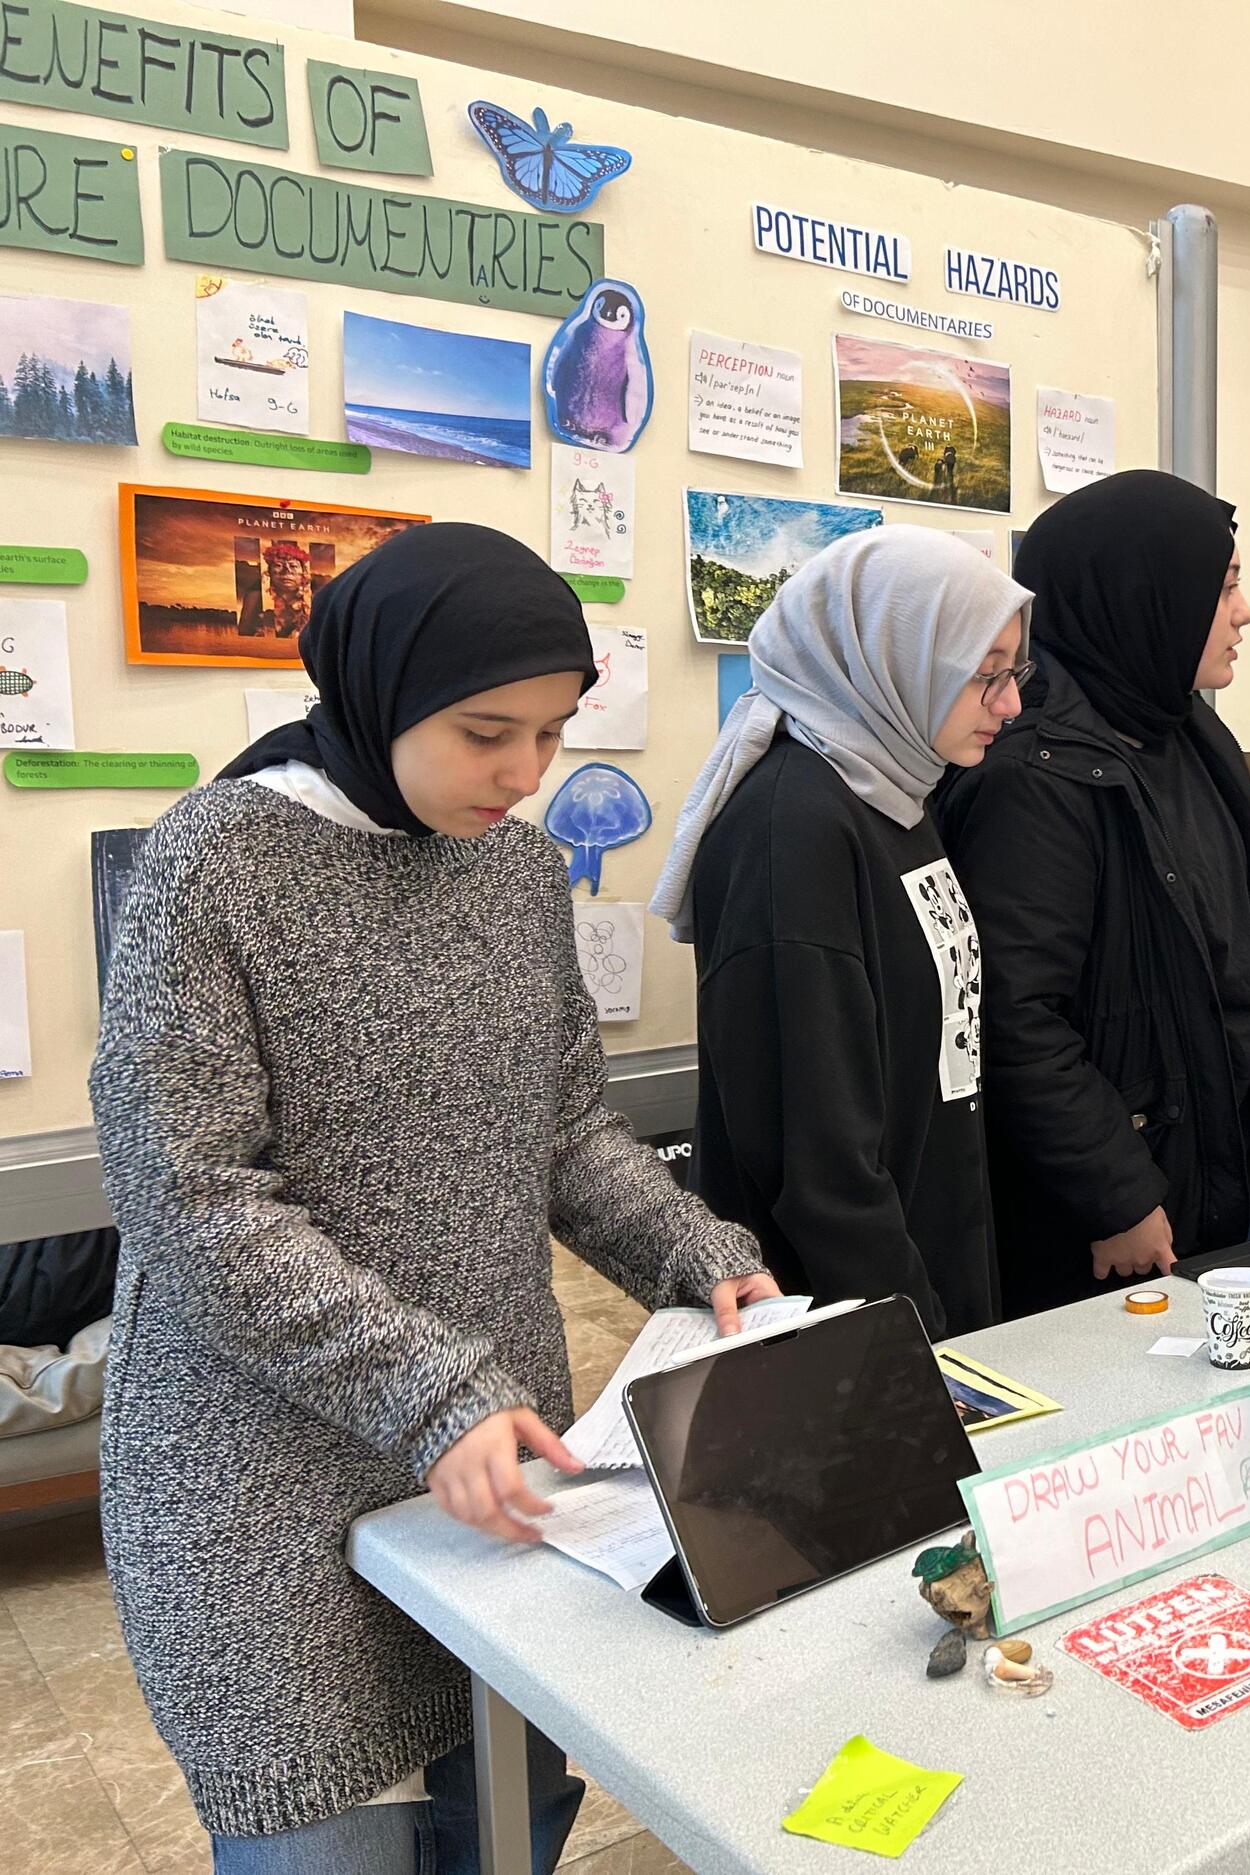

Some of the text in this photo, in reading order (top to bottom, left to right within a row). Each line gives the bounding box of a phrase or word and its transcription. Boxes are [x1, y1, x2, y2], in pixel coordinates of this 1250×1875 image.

[327, 75, 411, 156] OF
[756, 205, 1059, 310] POTENTIAL HAZARDS
[842, 291, 993, 339] OF DOCUMENTARIES
[699, 349, 795, 382] PERCEPTION noun
[902, 411, 954, 429] PLANET
[1044, 405, 1082, 423] HAZARD
[171, 429, 201, 441] Habitat
[253, 440, 288, 451] Outright
[907, 425, 951, 441] EARTH
[172, 440, 182, 450] by
[202, 446, 233, 456] species
[924, 440, 935, 451] III
[238, 518, 331, 533] PLANET EARTH
[33, 556, 67, 565] surface
[585, 695, 608, 712] Fox
[15, 758, 81, 769] Deforestation:
[84, 759, 100, 768] The
[101, 759, 137, 770] clearing
[149, 759, 186, 770] thinning
[187, 760, 196, 768] of
[16, 770, 48, 780] forests
[1004, 1407, 1243, 1524] DRAW YOUR FAV
[1084, 1471, 1246, 1579] ANIMAL
